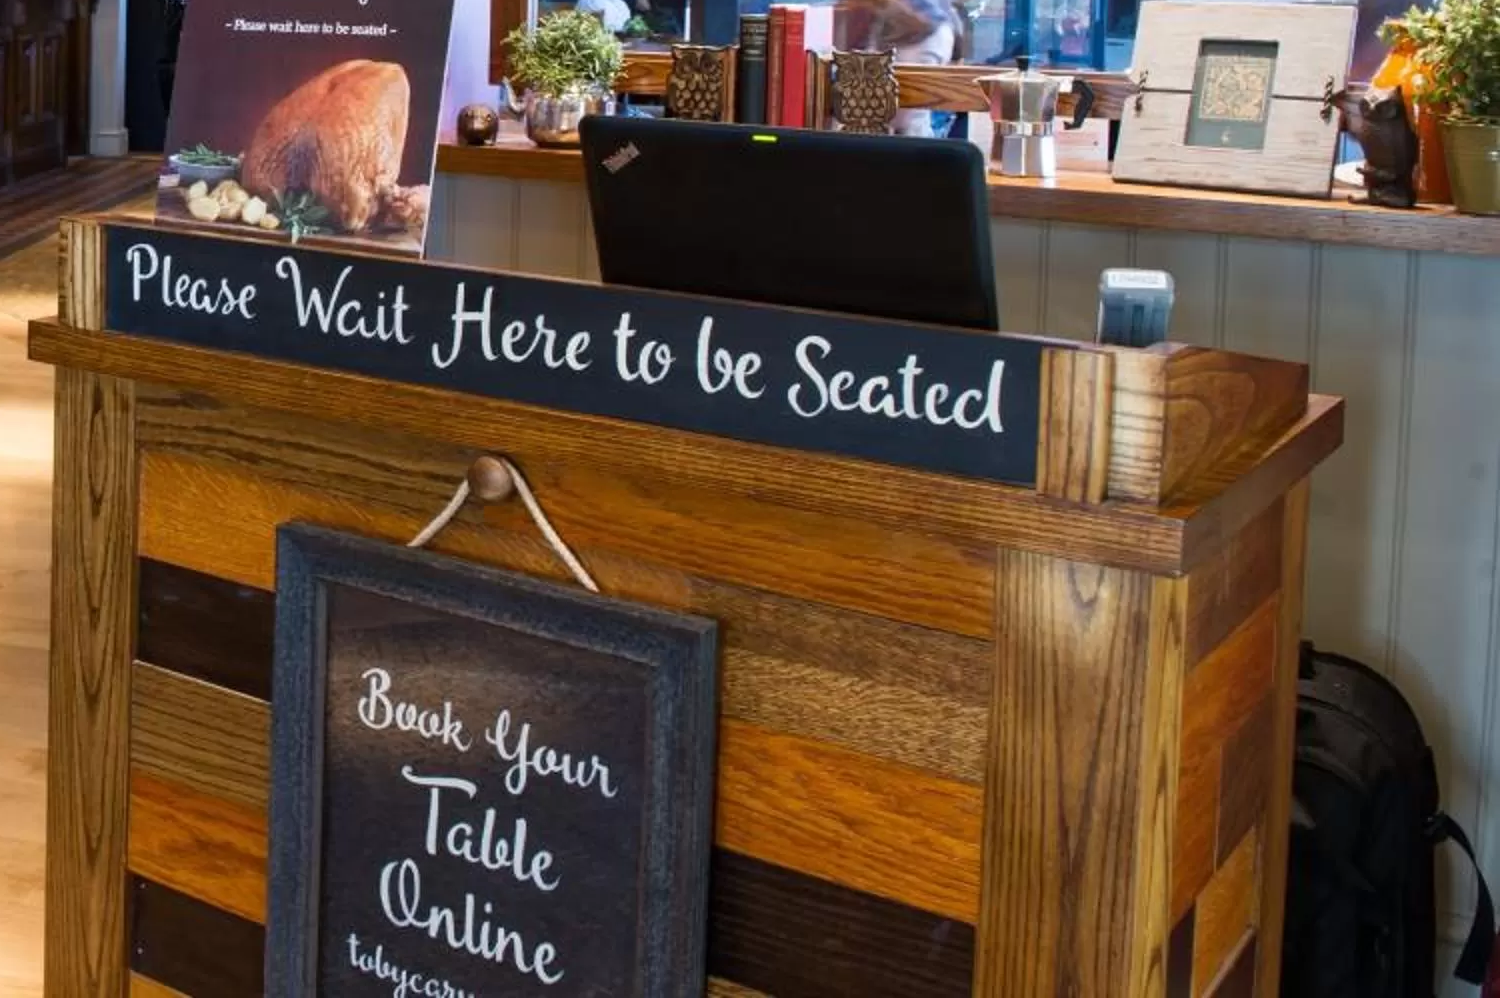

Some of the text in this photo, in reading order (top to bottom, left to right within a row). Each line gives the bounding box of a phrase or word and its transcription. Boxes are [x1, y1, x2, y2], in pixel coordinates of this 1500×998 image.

[233, 18, 266, 32] Please
[268, 20, 293, 33] wait
[295, 20, 320, 34] here
[322, 21, 333, 34] to
[336, 22, 349, 35] be
[350, 23, 387, 36] seated
[125, 242, 1006, 433] Please Wait Here to be Seated
[358, 667, 618, 798] Book Your
[401, 765, 561, 892] Table
[379, 858, 564, 985] Online
